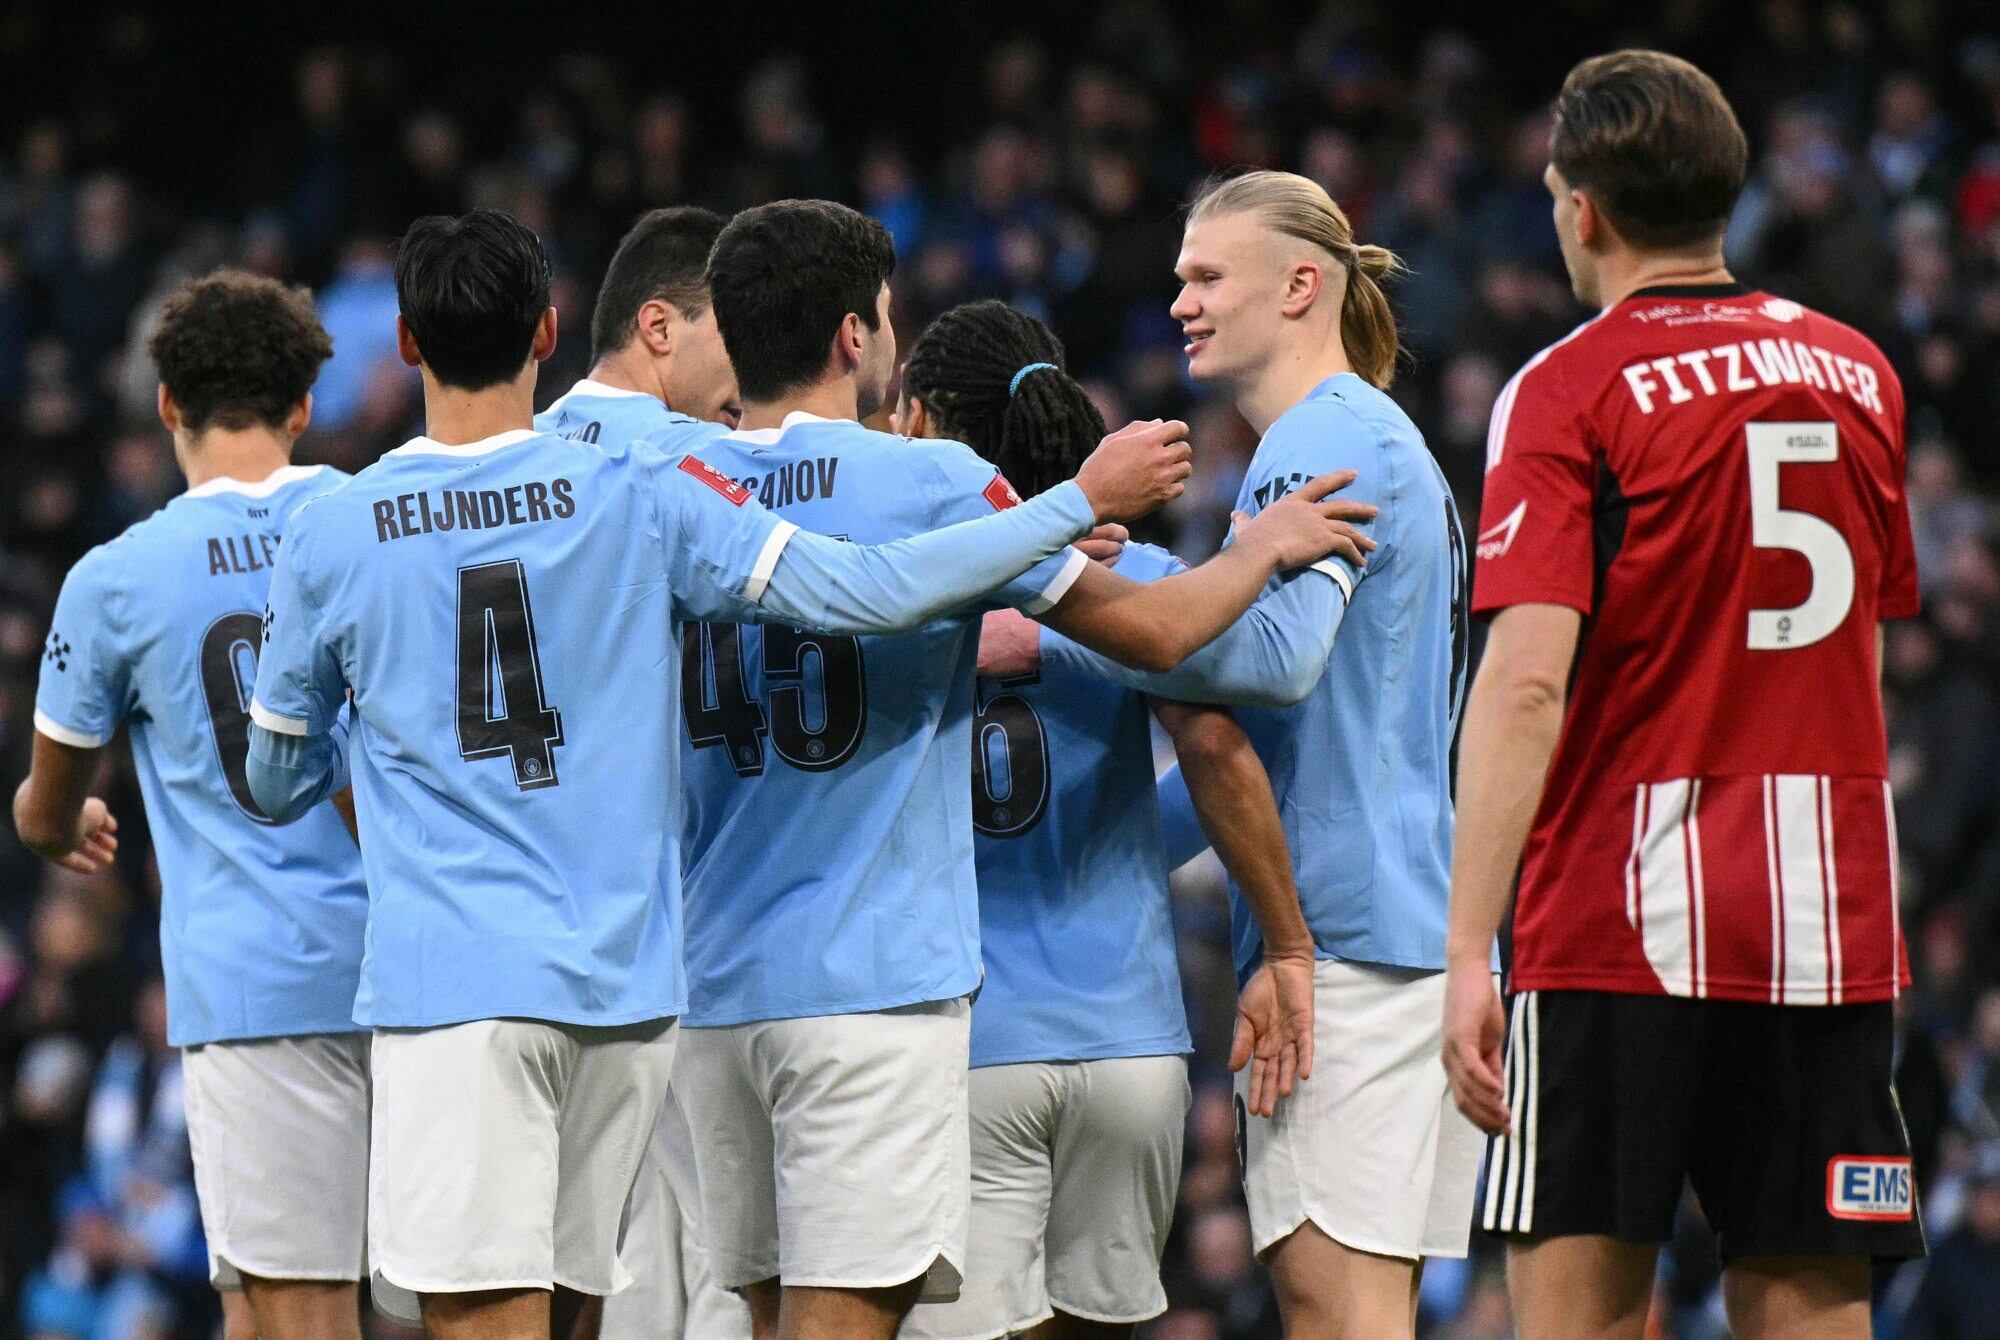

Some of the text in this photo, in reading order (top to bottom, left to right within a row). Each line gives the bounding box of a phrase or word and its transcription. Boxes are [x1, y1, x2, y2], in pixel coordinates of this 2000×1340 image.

[1622, 337, 1883, 414] FITZWATER
[373, 478, 576, 543] REIJNDERS
[731, 457, 838, 510] ANOV
[1745, 421, 1855, 650] 5
[455, 558, 565, 792] 4
[1842, 1166, 1909, 1204] EMS
